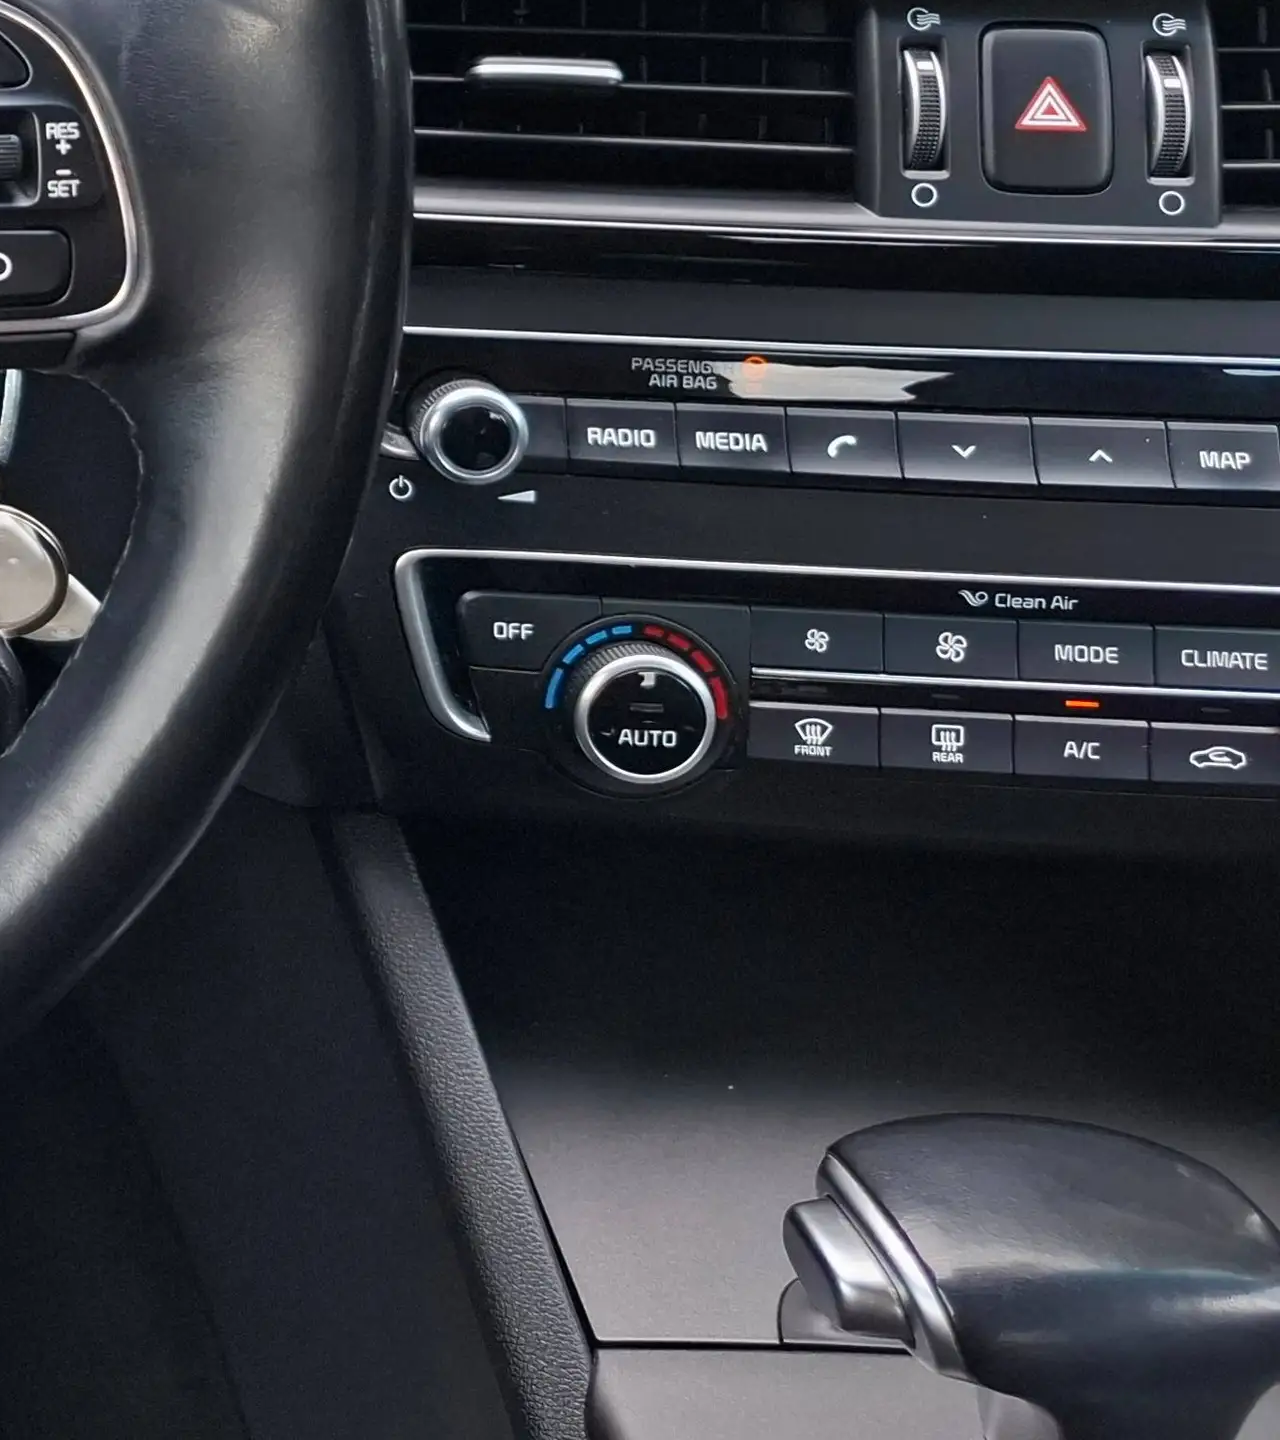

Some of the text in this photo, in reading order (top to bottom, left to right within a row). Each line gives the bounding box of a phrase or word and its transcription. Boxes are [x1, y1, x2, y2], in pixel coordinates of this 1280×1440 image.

[46, 123, 80, 139] RES
[47, 180, 80, 197] SET
[631, 358, 731, 375] PASSENG
[648, 375, 717, 390] AIR BAG
[588, 428, 656, 447] RADIO
[695, 431, 767, 452] MEDIA
[1199, 450, 1250, 469] MAP
[994, 593, 1078, 611] Clean Air
[493, 622, 534, 640] OFF
[1054, 645, 1119, 664] MODE
[1181, 650, 1268, 670] CLIMATE
[619, 729, 677, 747] AUTO
[795, 746, 832, 756] FRONT
[932, 752, 964, 763] REAR
[1064, 741, 1100, 760] A/C
